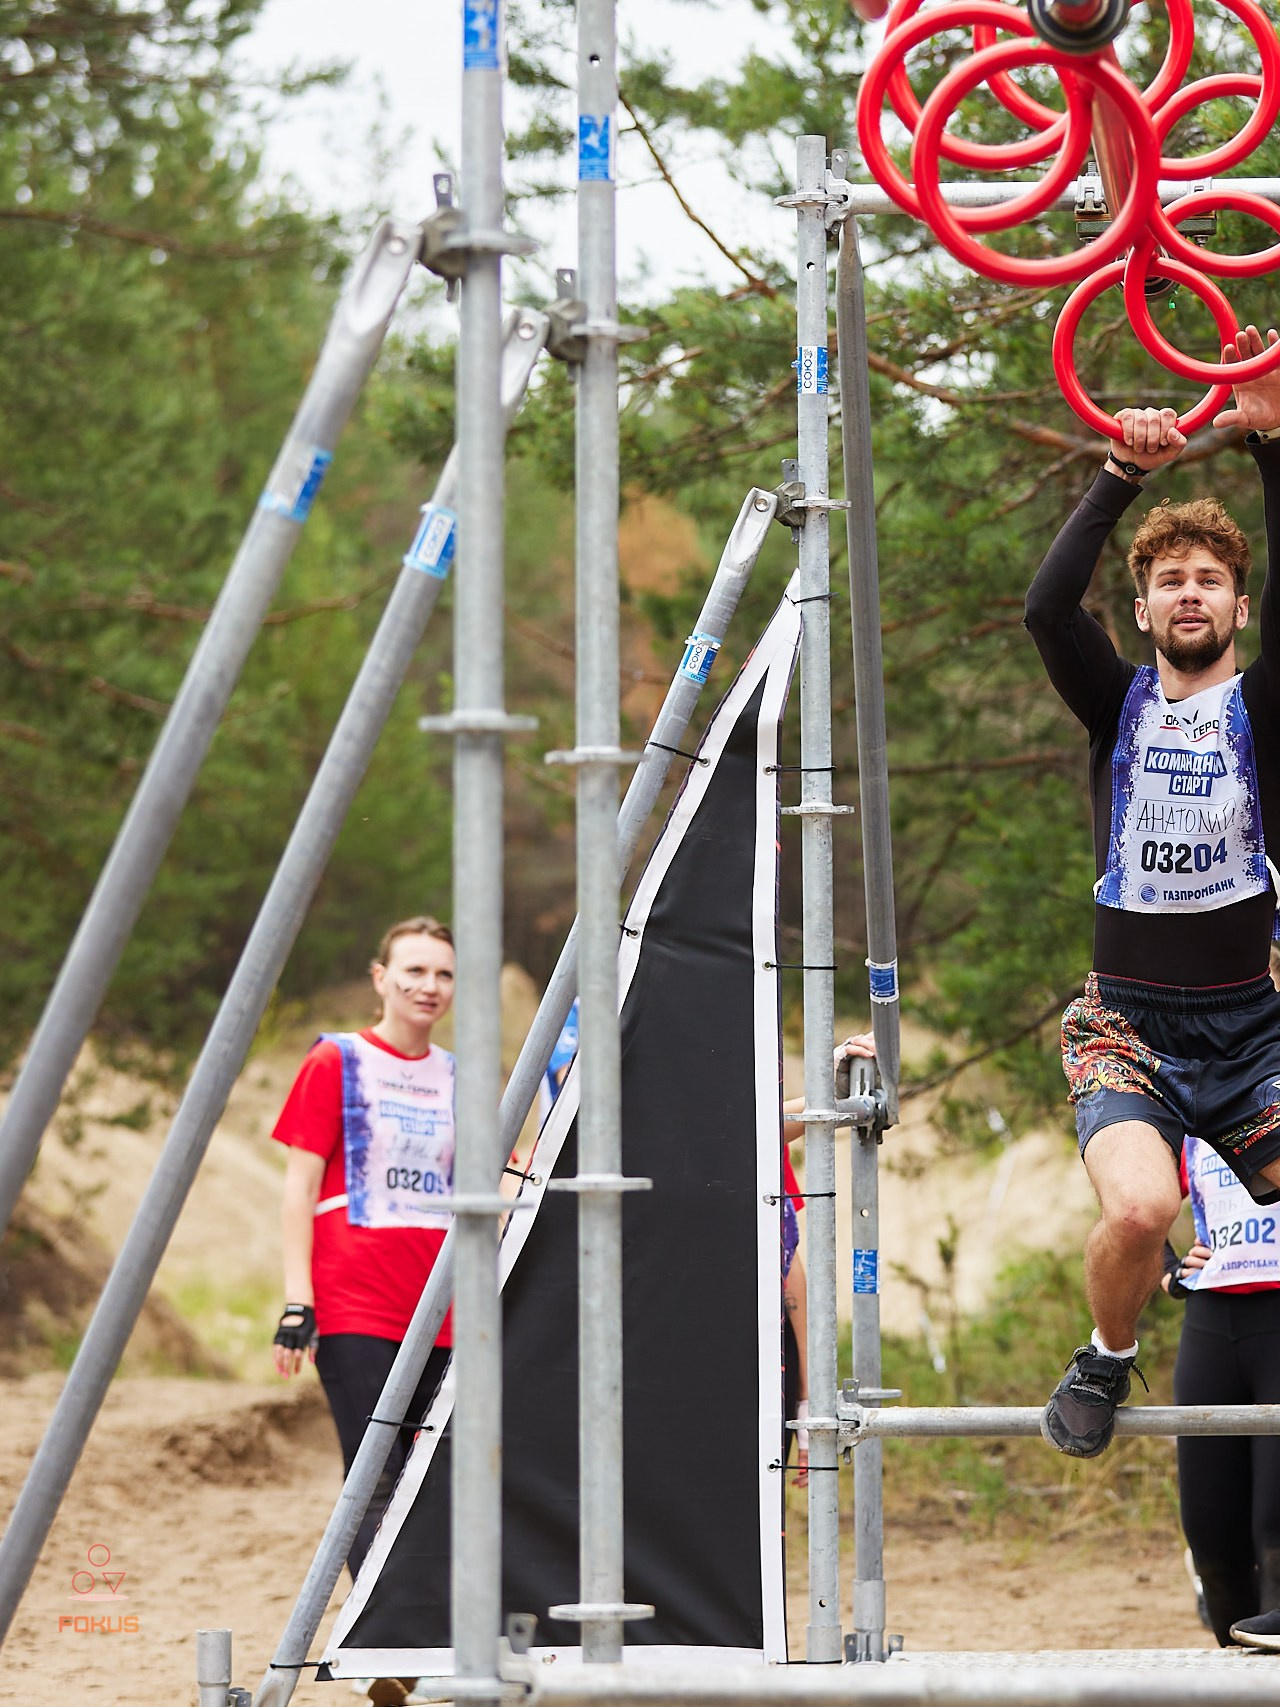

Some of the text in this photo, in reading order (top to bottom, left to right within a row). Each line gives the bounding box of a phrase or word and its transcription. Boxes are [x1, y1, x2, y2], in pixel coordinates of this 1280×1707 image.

[1193, 719, 1219, 739] ГЕРО
[1147, 751, 1225, 775] КОМАНДН
[1172, 775, 1210, 795] СТАРТ
[1141, 837, 1227, 873] 03204
[1164, 878, 1235, 900] ГАЗПРОМБАНК
[1220, 1259, 1279, 1271] АЗПРОМБАНК
